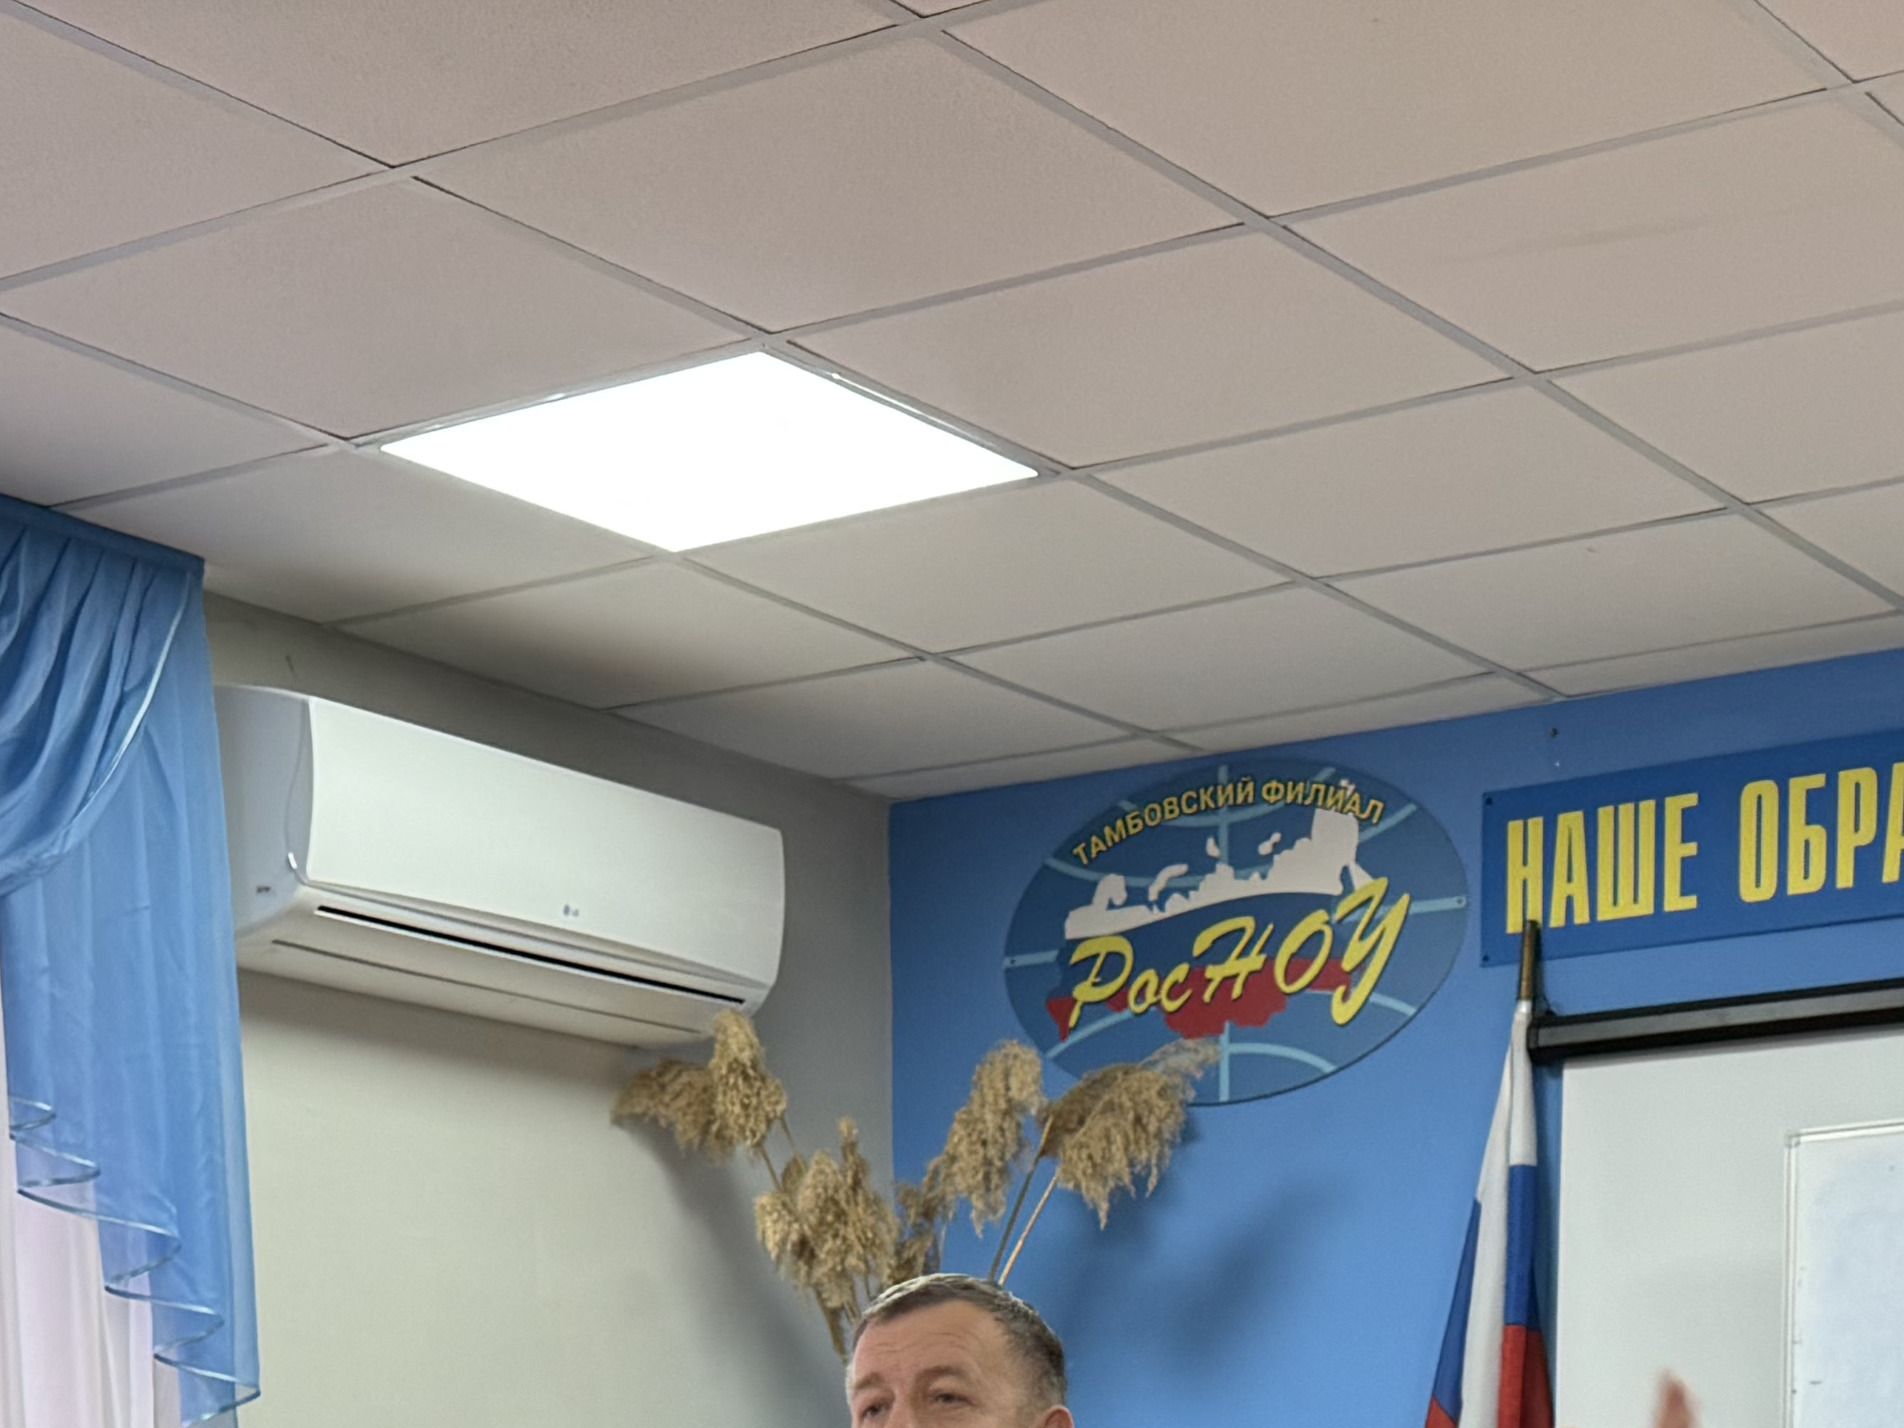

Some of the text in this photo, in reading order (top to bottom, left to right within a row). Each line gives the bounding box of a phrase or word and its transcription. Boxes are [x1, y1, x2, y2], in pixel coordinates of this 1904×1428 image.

[1072, 776, 1386, 866] ТАМБОВСКИЙ ФИЛИАЛ
[1506, 793, 1700, 934] НАШЕ
[1068, 877, 1411, 1027] РосНОУ
